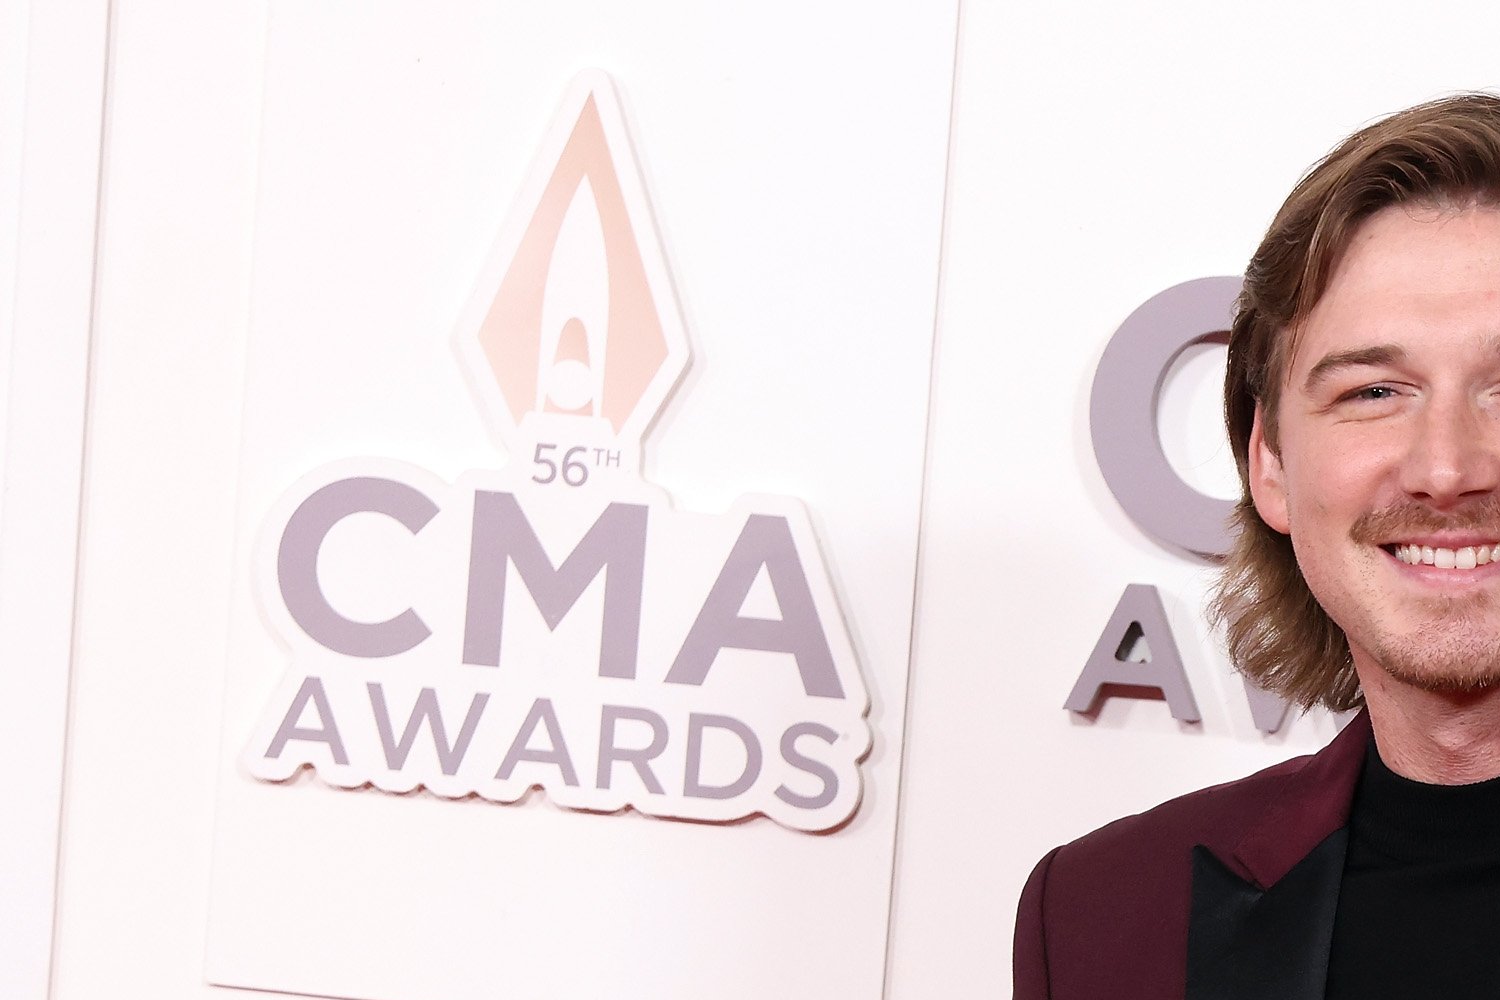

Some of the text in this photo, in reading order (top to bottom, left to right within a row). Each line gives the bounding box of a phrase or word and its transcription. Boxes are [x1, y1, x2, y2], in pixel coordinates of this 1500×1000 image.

[531, 443, 622, 487] 56TH
[276, 476, 846, 700] CMA
[263, 676, 840, 811] AWARDS
